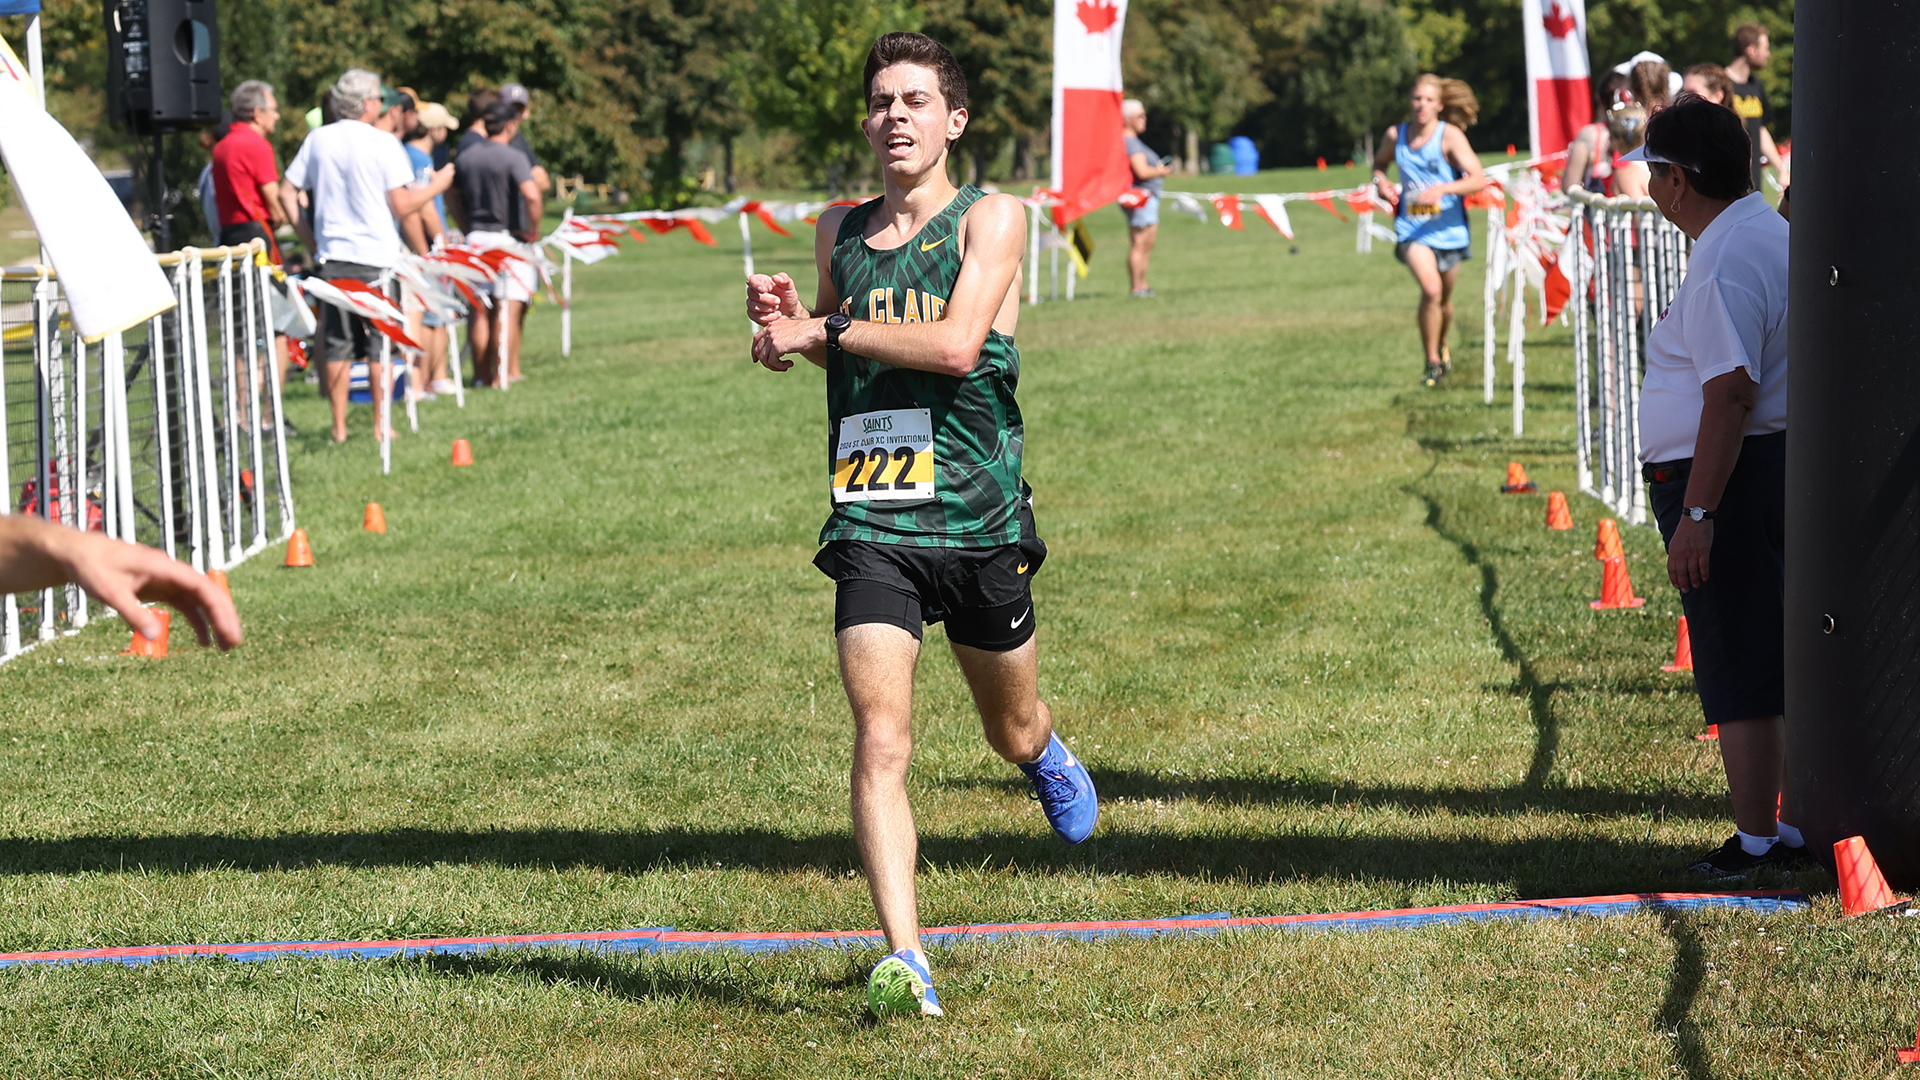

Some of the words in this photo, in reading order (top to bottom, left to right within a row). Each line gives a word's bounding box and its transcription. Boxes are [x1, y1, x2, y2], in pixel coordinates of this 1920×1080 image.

[862, 415, 893, 432] SAINTS
[839, 442, 852, 450] 2024
[875, 436, 885, 444] XC
[886, 434, 930, 444] INVITATIONAL
[845, 446, 916, 493] 222
